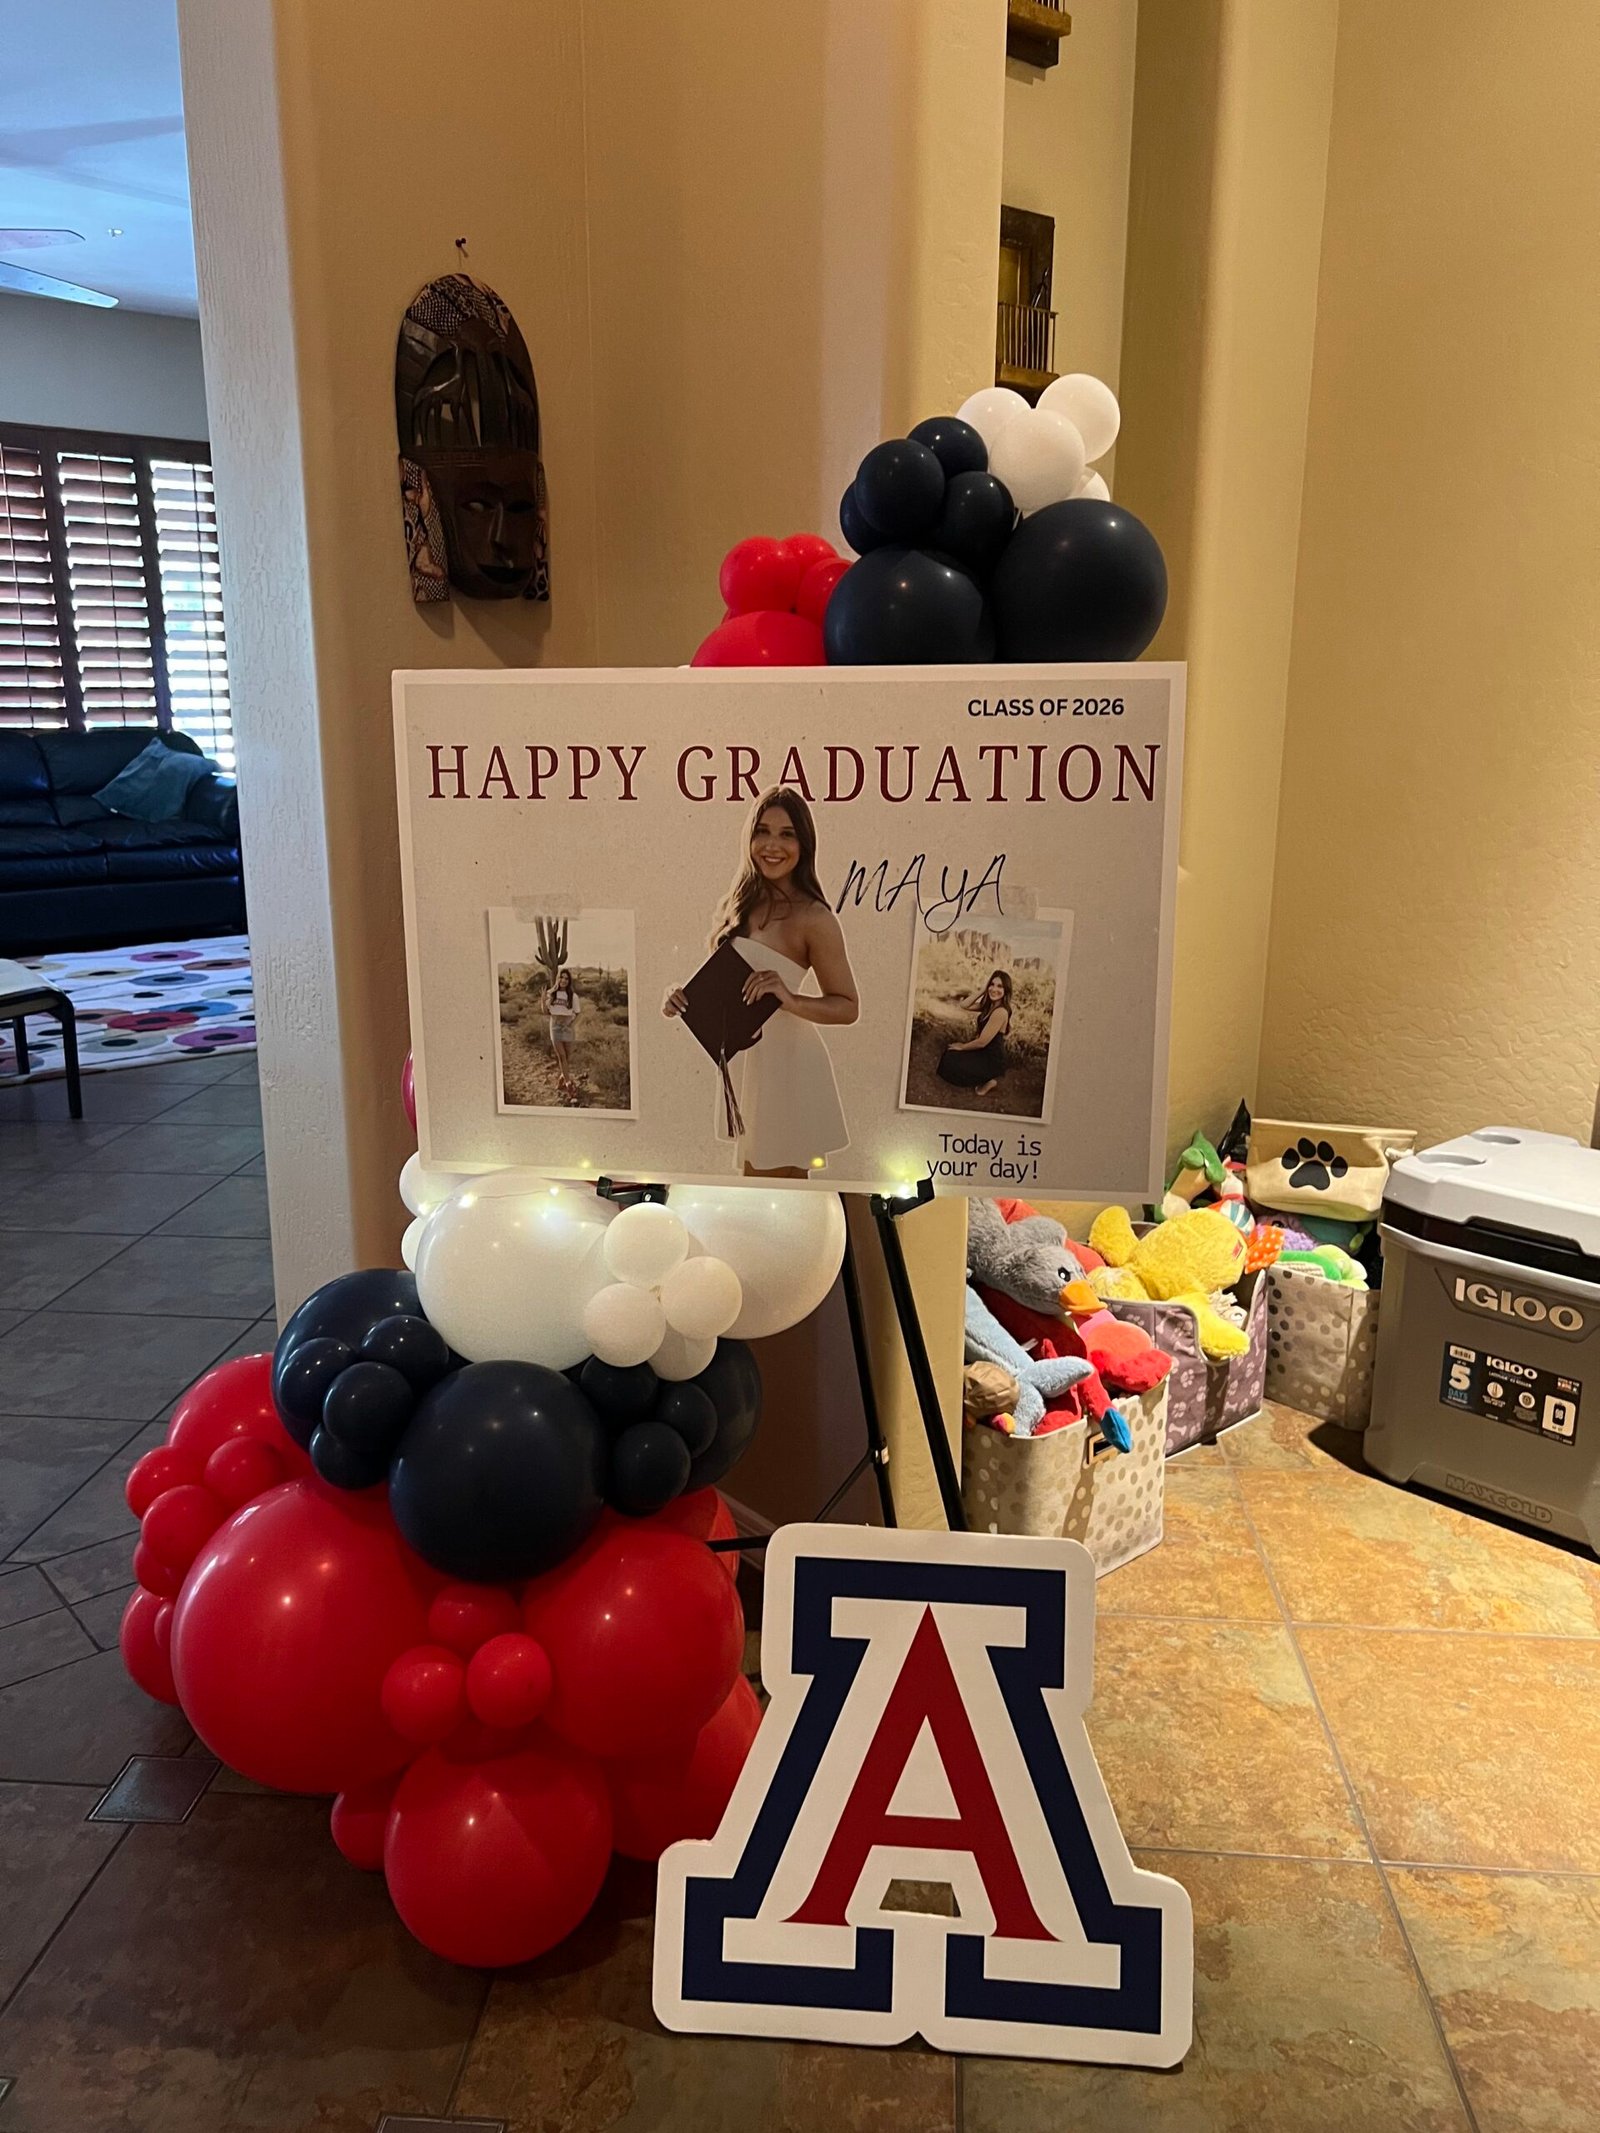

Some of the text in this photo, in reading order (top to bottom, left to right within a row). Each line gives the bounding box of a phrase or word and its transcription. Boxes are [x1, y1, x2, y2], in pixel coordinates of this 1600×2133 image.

[967, 698, 1125, 717] CLASS OF 2026
[426, 743, 1162, 803] HAPPY GRADUATION
[938, 1132, 1042, 1160] Today is
[926, 1157, 1038, 1184] your day!
[1454, 1277, 1584, 1332] IGLOO
[1448, 1363, 1471, 1391] 5
[1486, 1355, 1538, 1380] IGLOO
[1447, 1387, 1468, 1401] DAYS
[1445, 1473, 1553, 1524] MAXCOLD
[681, 1555, 1163, 2036] A
